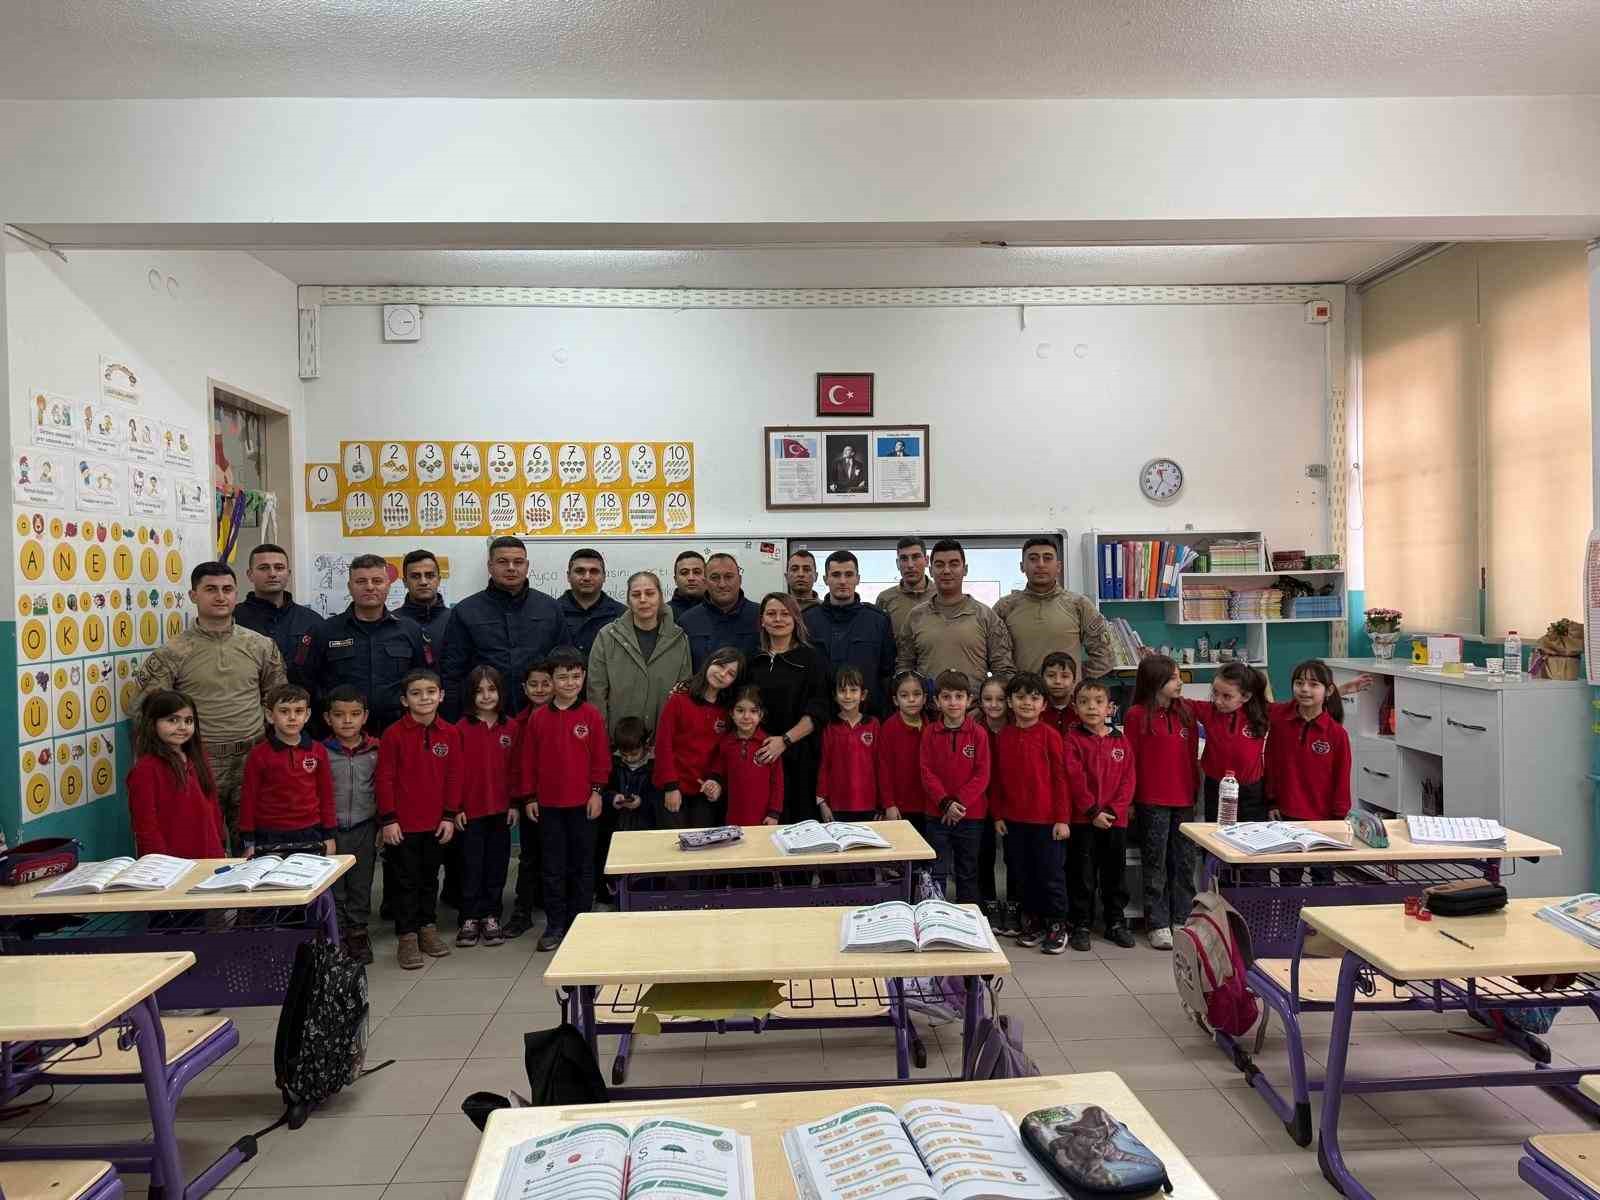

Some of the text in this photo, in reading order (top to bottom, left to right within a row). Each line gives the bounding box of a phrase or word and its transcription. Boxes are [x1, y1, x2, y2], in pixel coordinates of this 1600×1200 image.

[354, 444, 685, 460] 1 2 3 4 5 6 7 8 9 10
[318, 466, 328, 482] 0
[353, 492, 687, 508] 11 12 13 14 15 16 17 18 19 20
[27, 550, 38, 569] A
[60, 551, 71, 571] N
[92, 553, 100, 573] E
[119, 553, 127, 572] T
[171, 557, 178, 575] L
[28, 629, 40, 649] O
[64, 626, 72, 647] K
[89, 623, 98, 643] U
[120, 620, 127, 638] R
[170, 619, 180, 637] M
[30, 690, 107, 726] Ü S Ö
[67, 775, 76, 795] B
[97, 767, 108, 786] G
